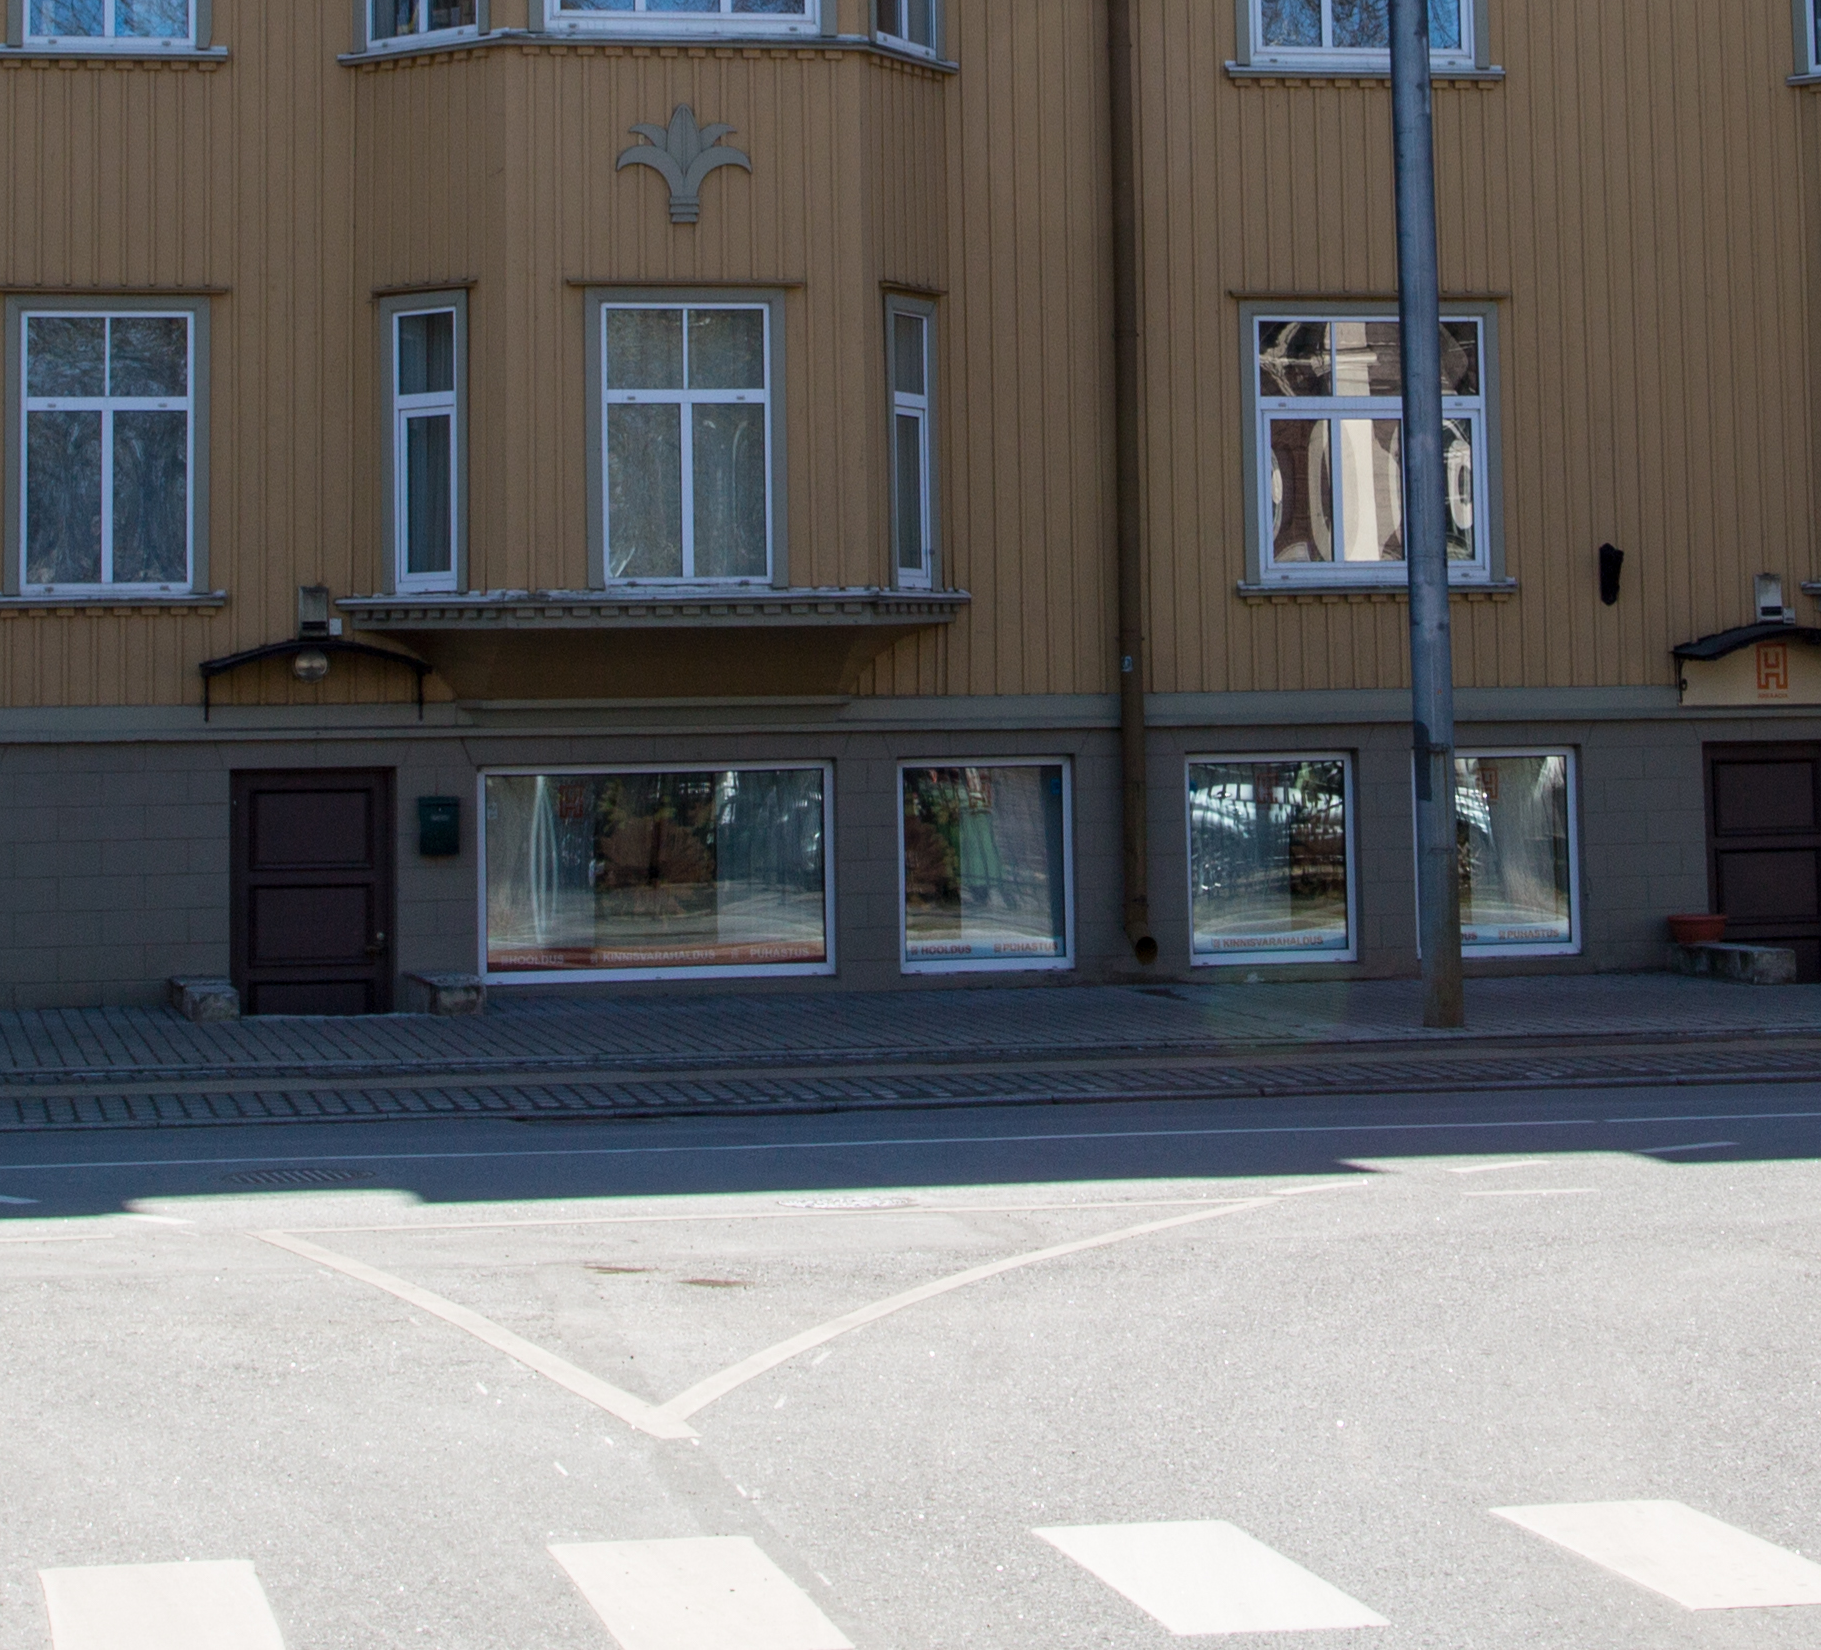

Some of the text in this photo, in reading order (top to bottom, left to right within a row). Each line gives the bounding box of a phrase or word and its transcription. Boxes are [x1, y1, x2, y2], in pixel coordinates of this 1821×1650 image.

[921, 941, 1059, 955] HOOLDUS PUHASTUS
[1222, 935, 1324, 948] KINNISVARAHALDUS
[509, 947, 810, 965] HOOLDUS KINNISVARAHALDUS PUHASTUS
